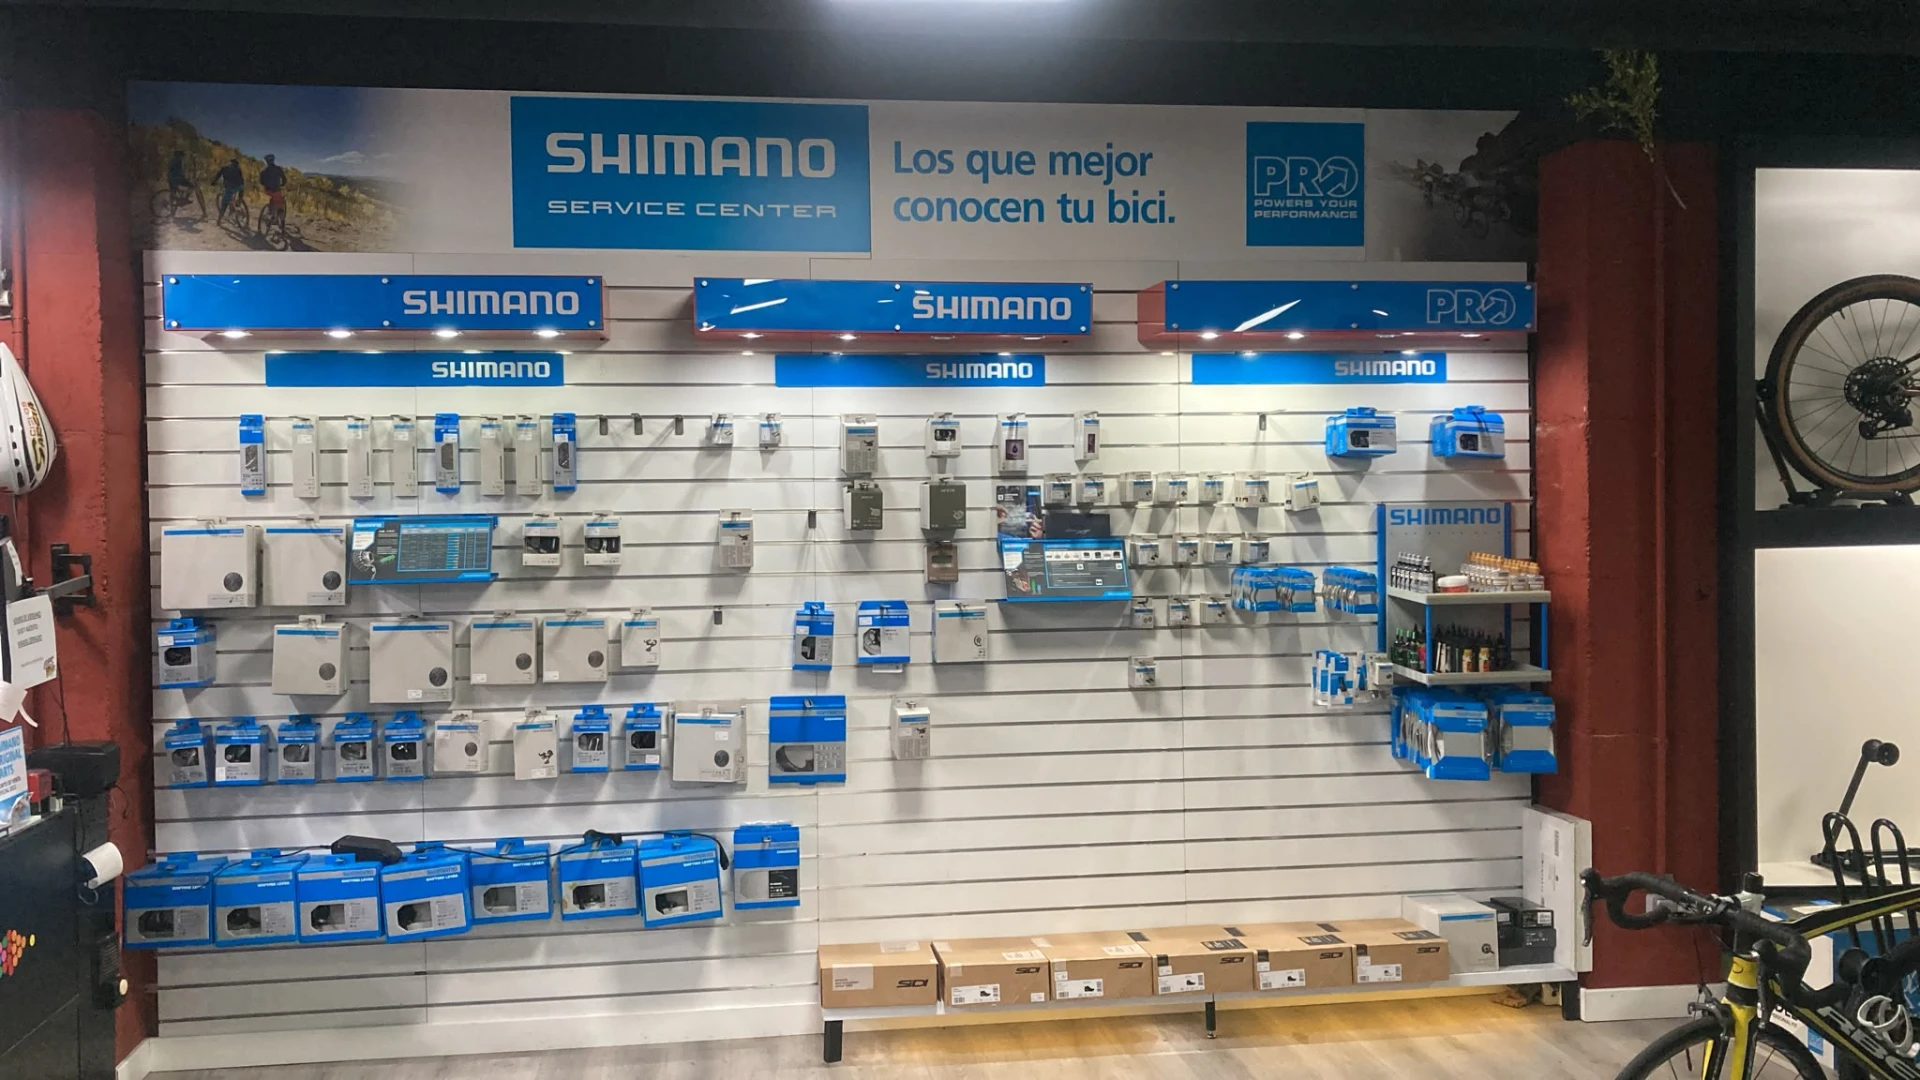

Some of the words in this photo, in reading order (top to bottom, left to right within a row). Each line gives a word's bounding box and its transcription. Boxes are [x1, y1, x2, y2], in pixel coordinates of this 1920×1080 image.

[546, 132, 836, 179] SHIMANO
[894, 141, 954, 174] Los
[966, 149, 1036, 184] que
[1049, 142, 1154, 186] mejor
[1254, 155, 1359, 198] PRO
[548, 200, 685, 216] SERVICE
[696, 202, 837, 219] CENTER
[893, 196, 1045, 223] conocen
[1056, 192, 1095, 224] tu
[1108, 189, 1176, 224] bici.
[1254, 199, 1314, 208] POWERS
[1319, 199, 1358, 208] YOUR
[1254, 210, 1358, 219] PERFORMANCE
[403, 290, 580, 315] SHIMANO
[912, 295, 1072, 321] SHIMANO
[1426, 288, 1516, 324] PRO
[431, 361, 551, 379] SHIMANO
[926, 362, 1033, 379] SHIMANO
[1334, 360, 1436, 376] SHIMANO
[1390, 507, 1501, 526] SHIMANO
